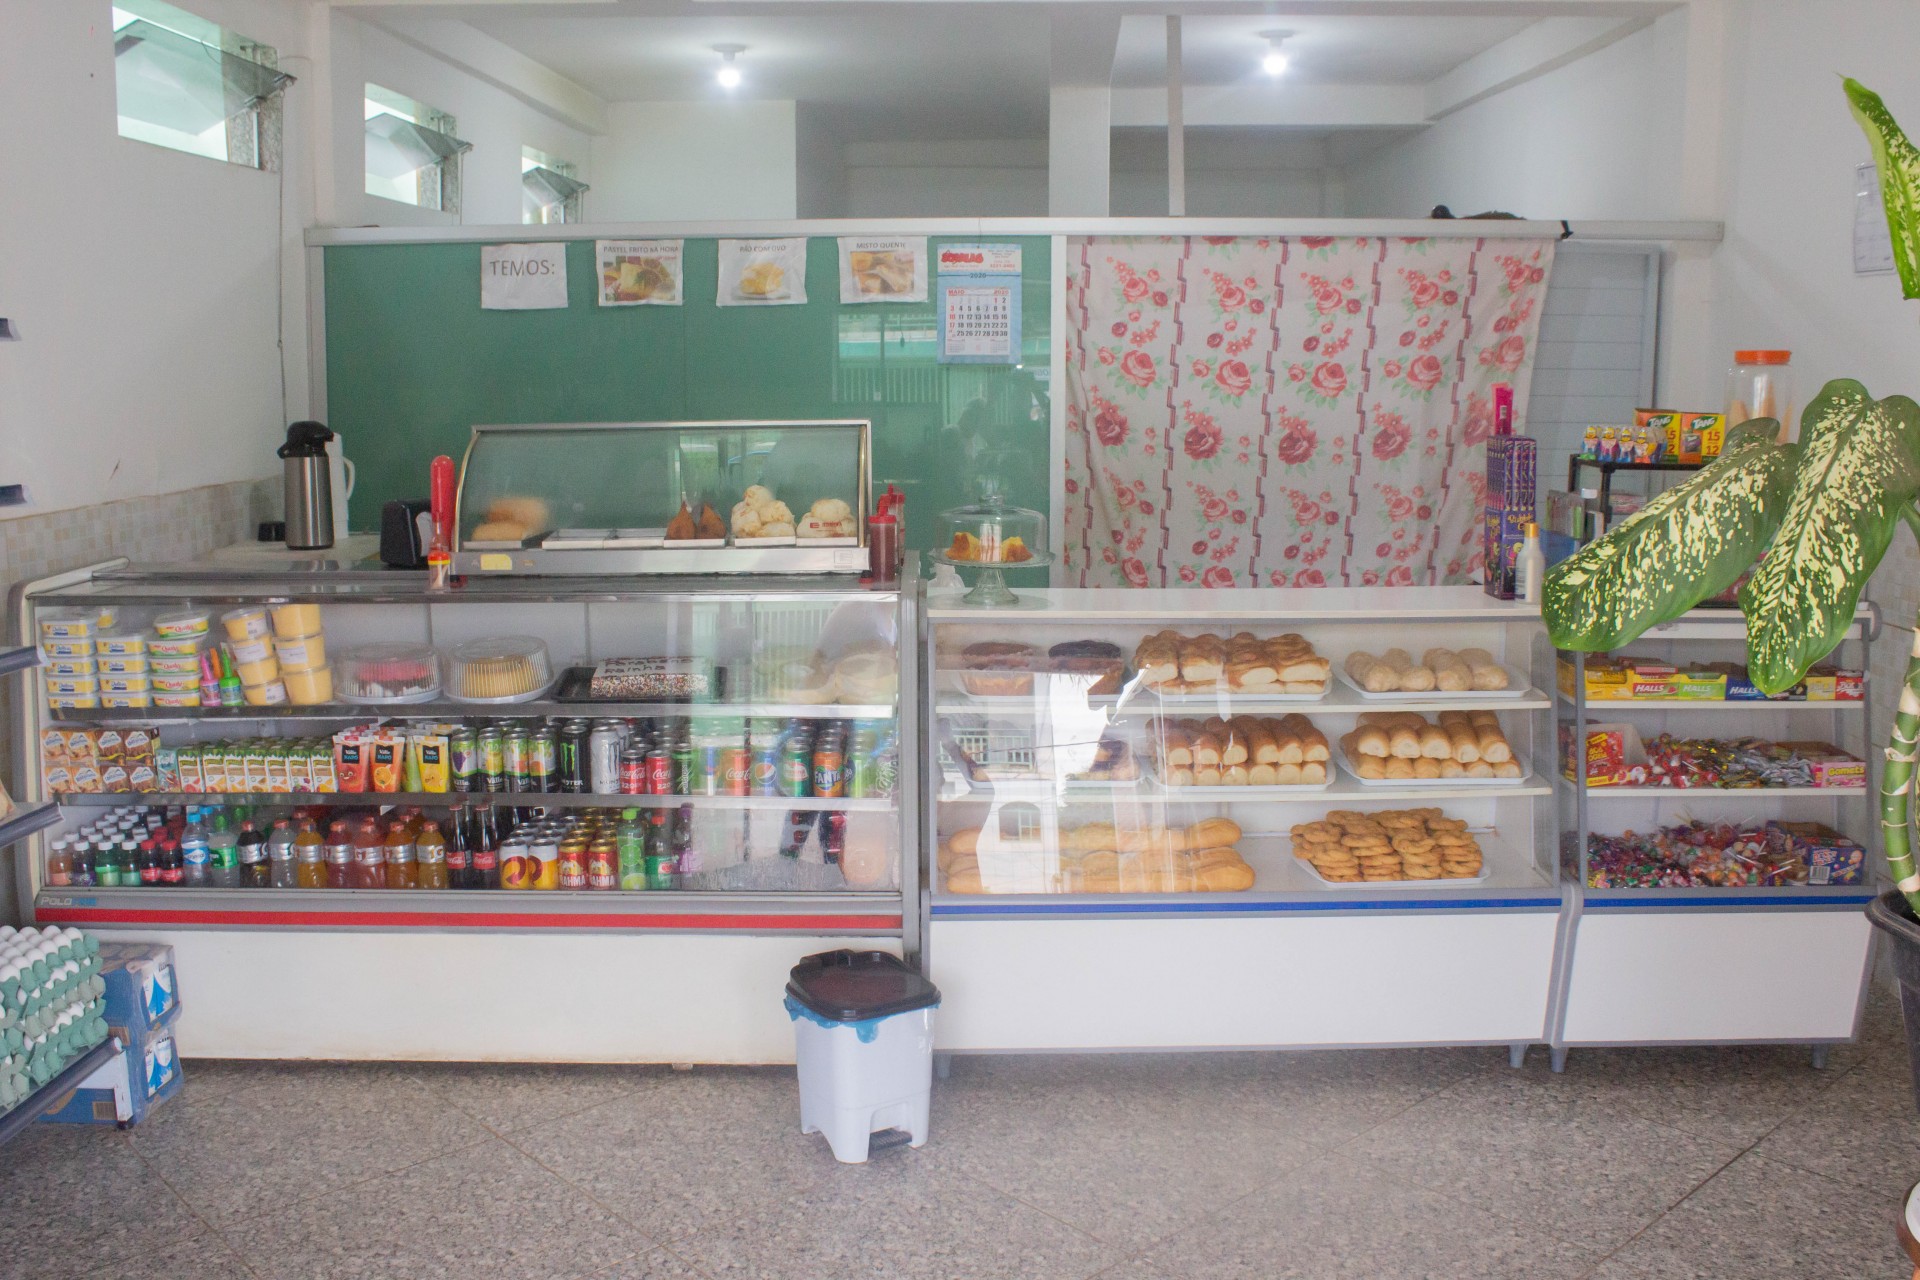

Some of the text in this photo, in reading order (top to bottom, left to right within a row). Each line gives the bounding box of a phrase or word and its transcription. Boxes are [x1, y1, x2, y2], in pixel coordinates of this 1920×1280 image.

[489, 260, 556, 276] TEMOS:
[1693, 418, 1715, 429] TANG
[1708, 432, 1720, 441] 15
[1706, 446, 1719, 455] 12
[1636, 684, 1664, 692] HALLS
[1683, 684, 1711, 692] HALLS
[1730, 686, 1758, 694] HALLS
[814, 770, 840, 784] FANTA
